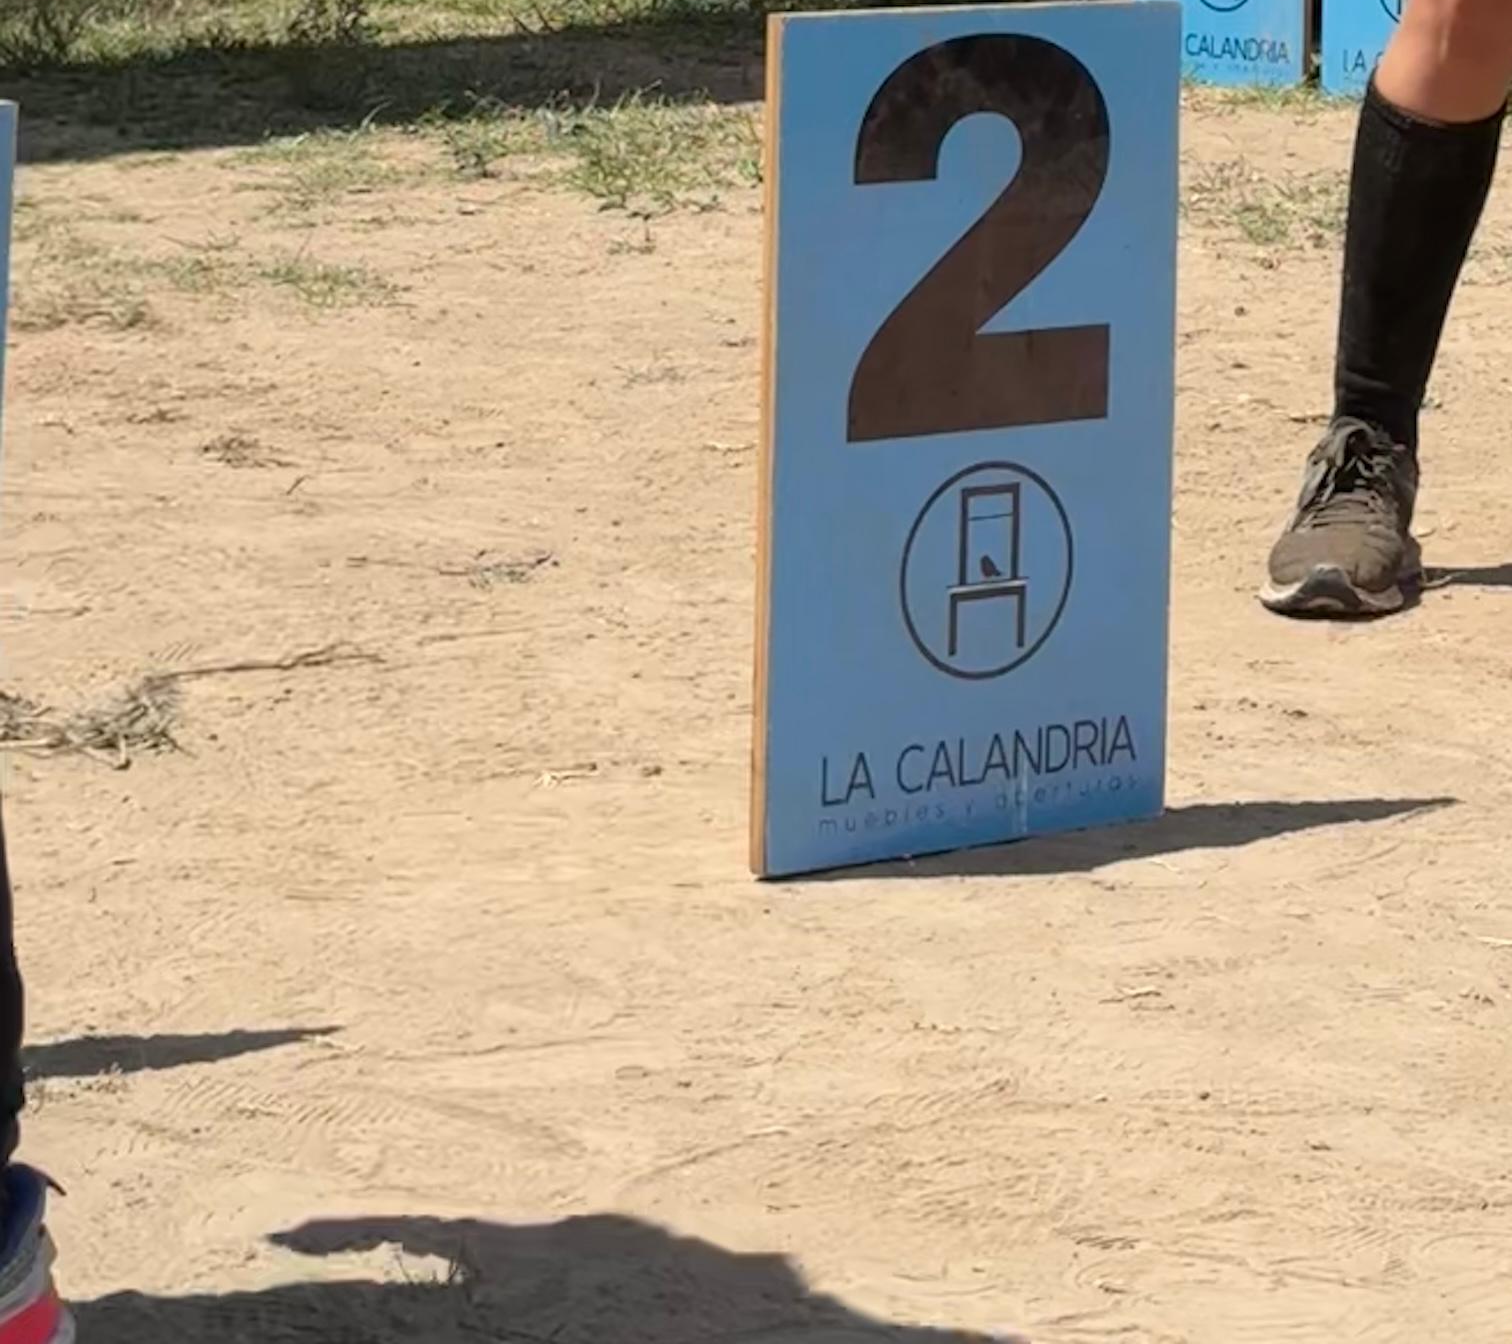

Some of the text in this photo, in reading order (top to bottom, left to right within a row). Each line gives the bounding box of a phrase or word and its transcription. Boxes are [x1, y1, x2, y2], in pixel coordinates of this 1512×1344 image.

[1185, 32, 1290, 64] CALANDRIA
[1343, 49, 1367, 73] LA
[846, 32, 1112, 444] 2
[821, 715, 1137, 808] LA CALANDRIA
